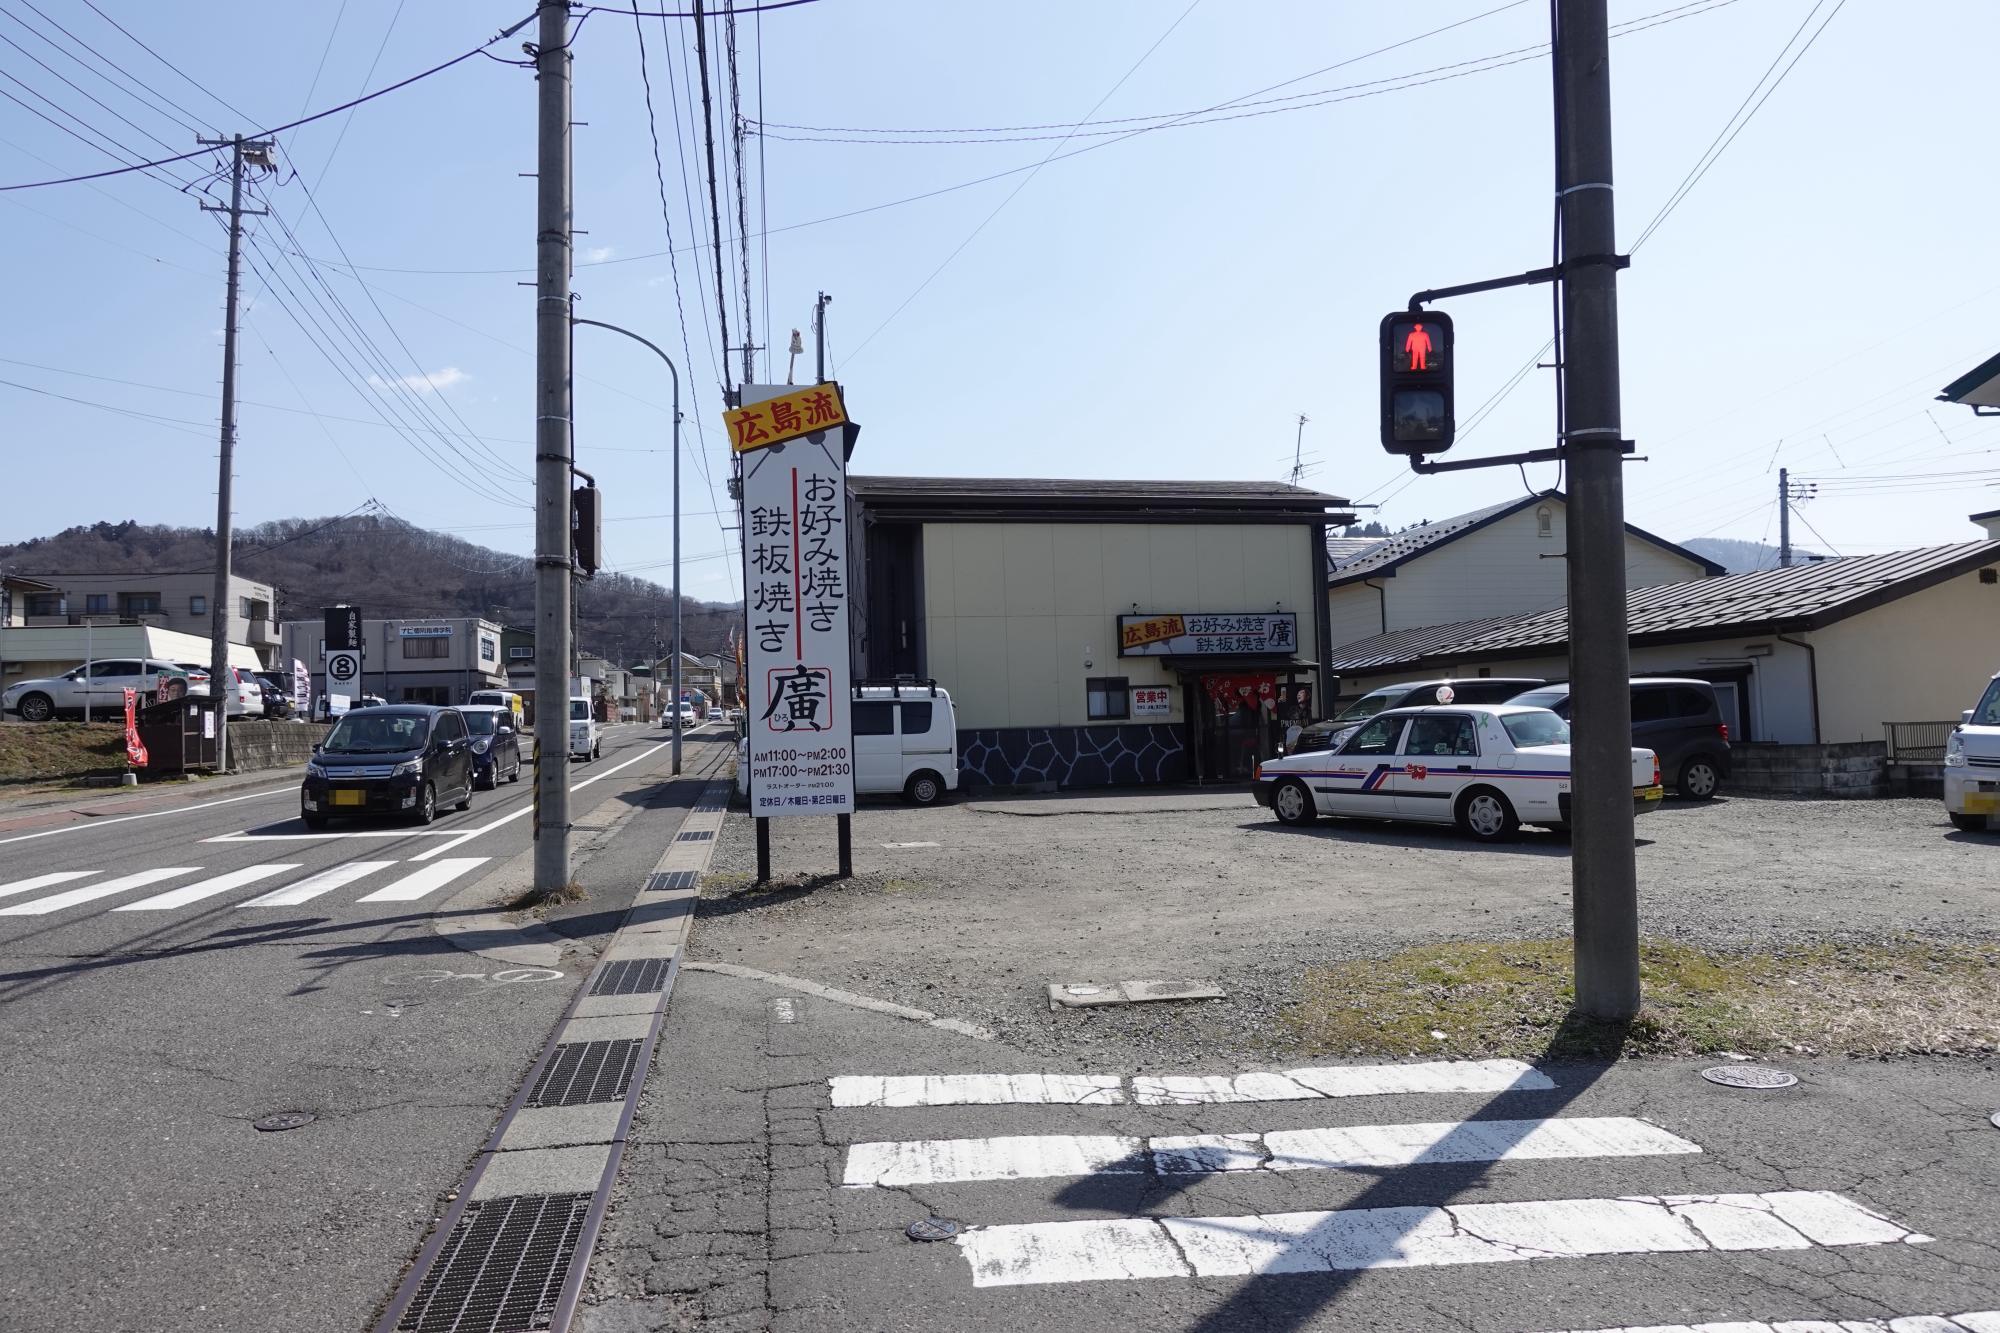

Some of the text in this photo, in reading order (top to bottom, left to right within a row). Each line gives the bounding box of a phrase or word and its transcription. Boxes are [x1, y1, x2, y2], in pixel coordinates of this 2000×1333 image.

[733, 391, 840, 447] 広島流
[800, 473, 844, 632] お好み焼き
[750, 506, 794, 653] 鉄板焼き
[1125, 618, 1182, 645] 広島流
[1189, 617, 1266, 633] お好み焼き
[1196, 636, 1267, 652] 鉄板焼き
[760, 664, 826, 733] 廣
[1135, 690, 1167, 703] 営業中
[773, 713, 789, 722] ひろ
